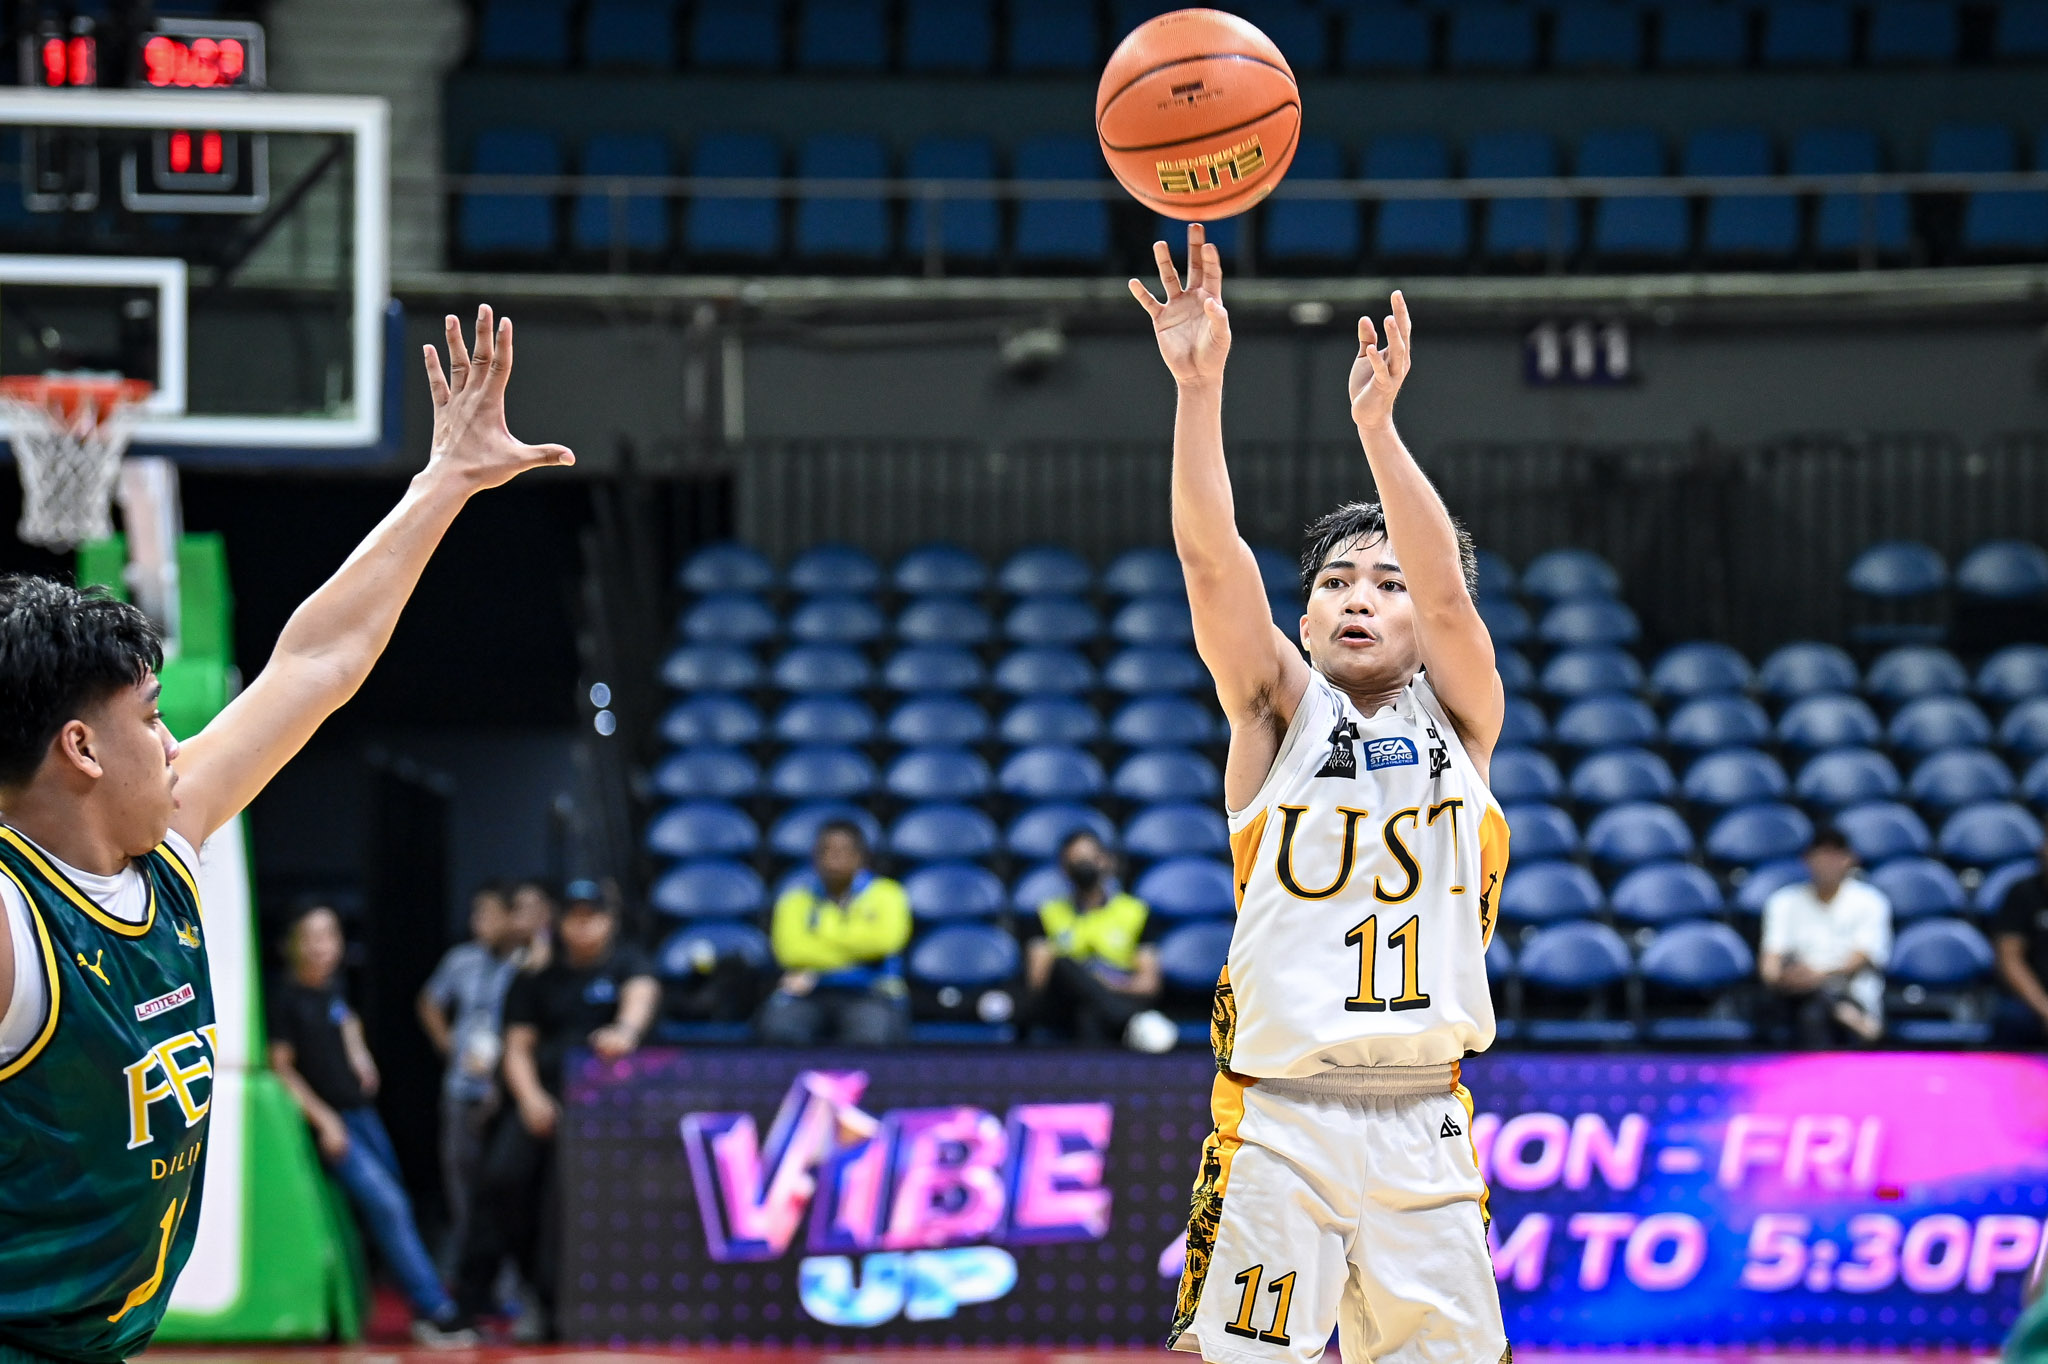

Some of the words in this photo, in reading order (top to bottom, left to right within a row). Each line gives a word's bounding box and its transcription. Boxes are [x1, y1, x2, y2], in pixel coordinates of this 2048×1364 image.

[1526, 320, 1630, 378] 111
[1370, 753, 1413, 765] STRONG
[1275, 797, 1465, 905] UST
[1344, 914, 1431, 1012] 11
[679, 1069, 1114, 1263] VIBE
[1717, 1112, 1885, 1191] FRI
[797, 1244, 1018, 1329] UP
[1568, 1211, 1707, 1292] TO
[1740, 1213, 2048, 1294] 5:30P
[1224, 1264, 1297, 1347] 11
